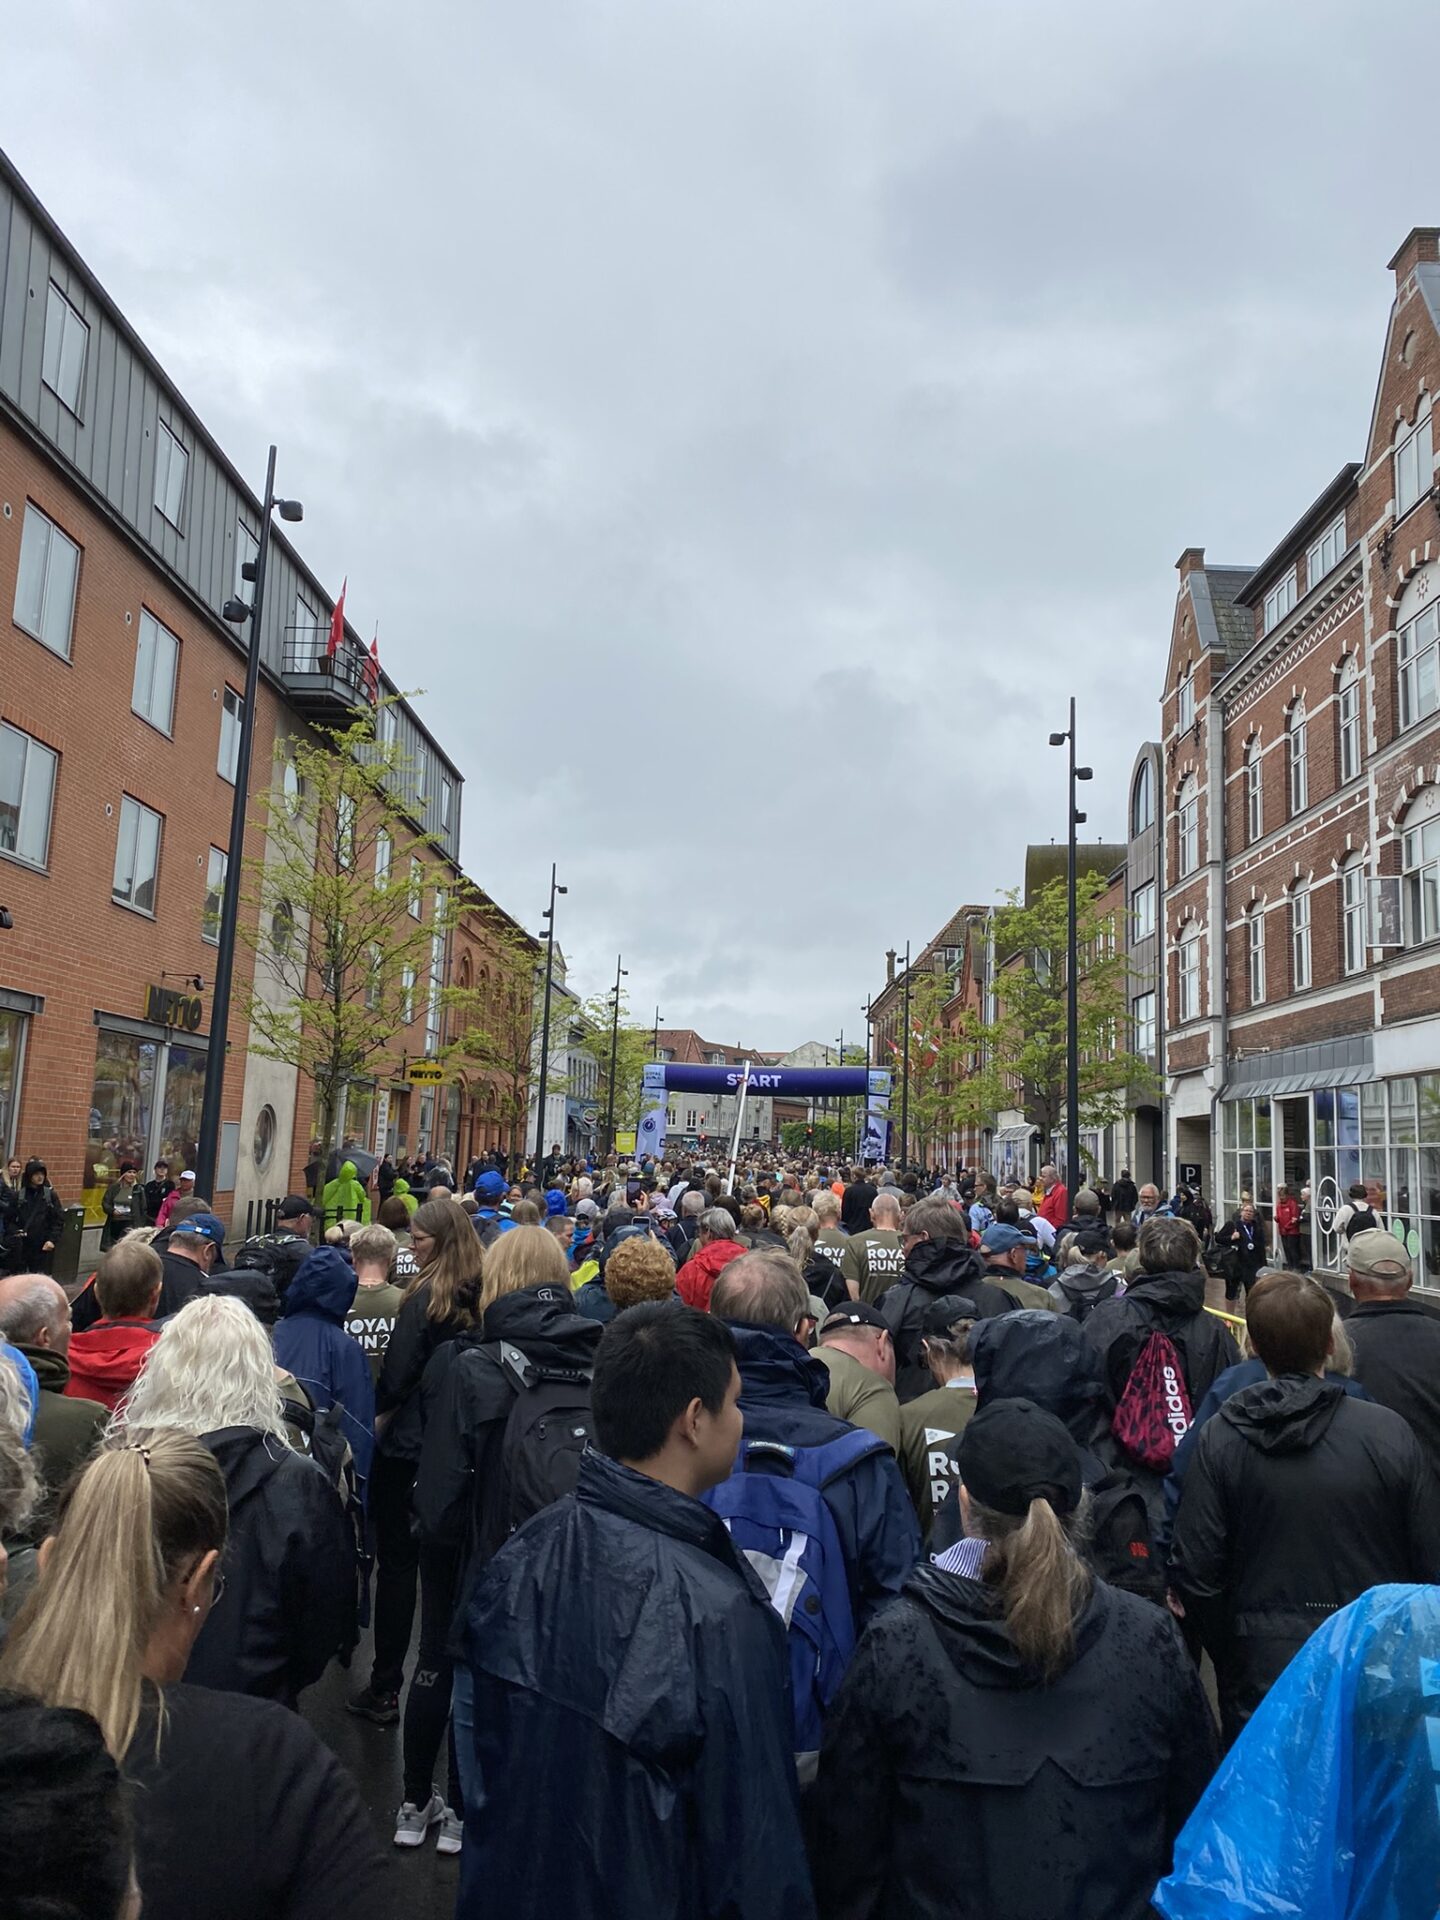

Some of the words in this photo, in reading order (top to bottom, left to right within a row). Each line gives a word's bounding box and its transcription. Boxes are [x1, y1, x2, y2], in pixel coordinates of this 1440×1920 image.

[409, 1069, 442, 1080] NETTO
[1186, 1167, 1196, 1182] P
[815, 1247, 845, 1257] ROYA
[867, 1248, 906, 1260] ROYA
